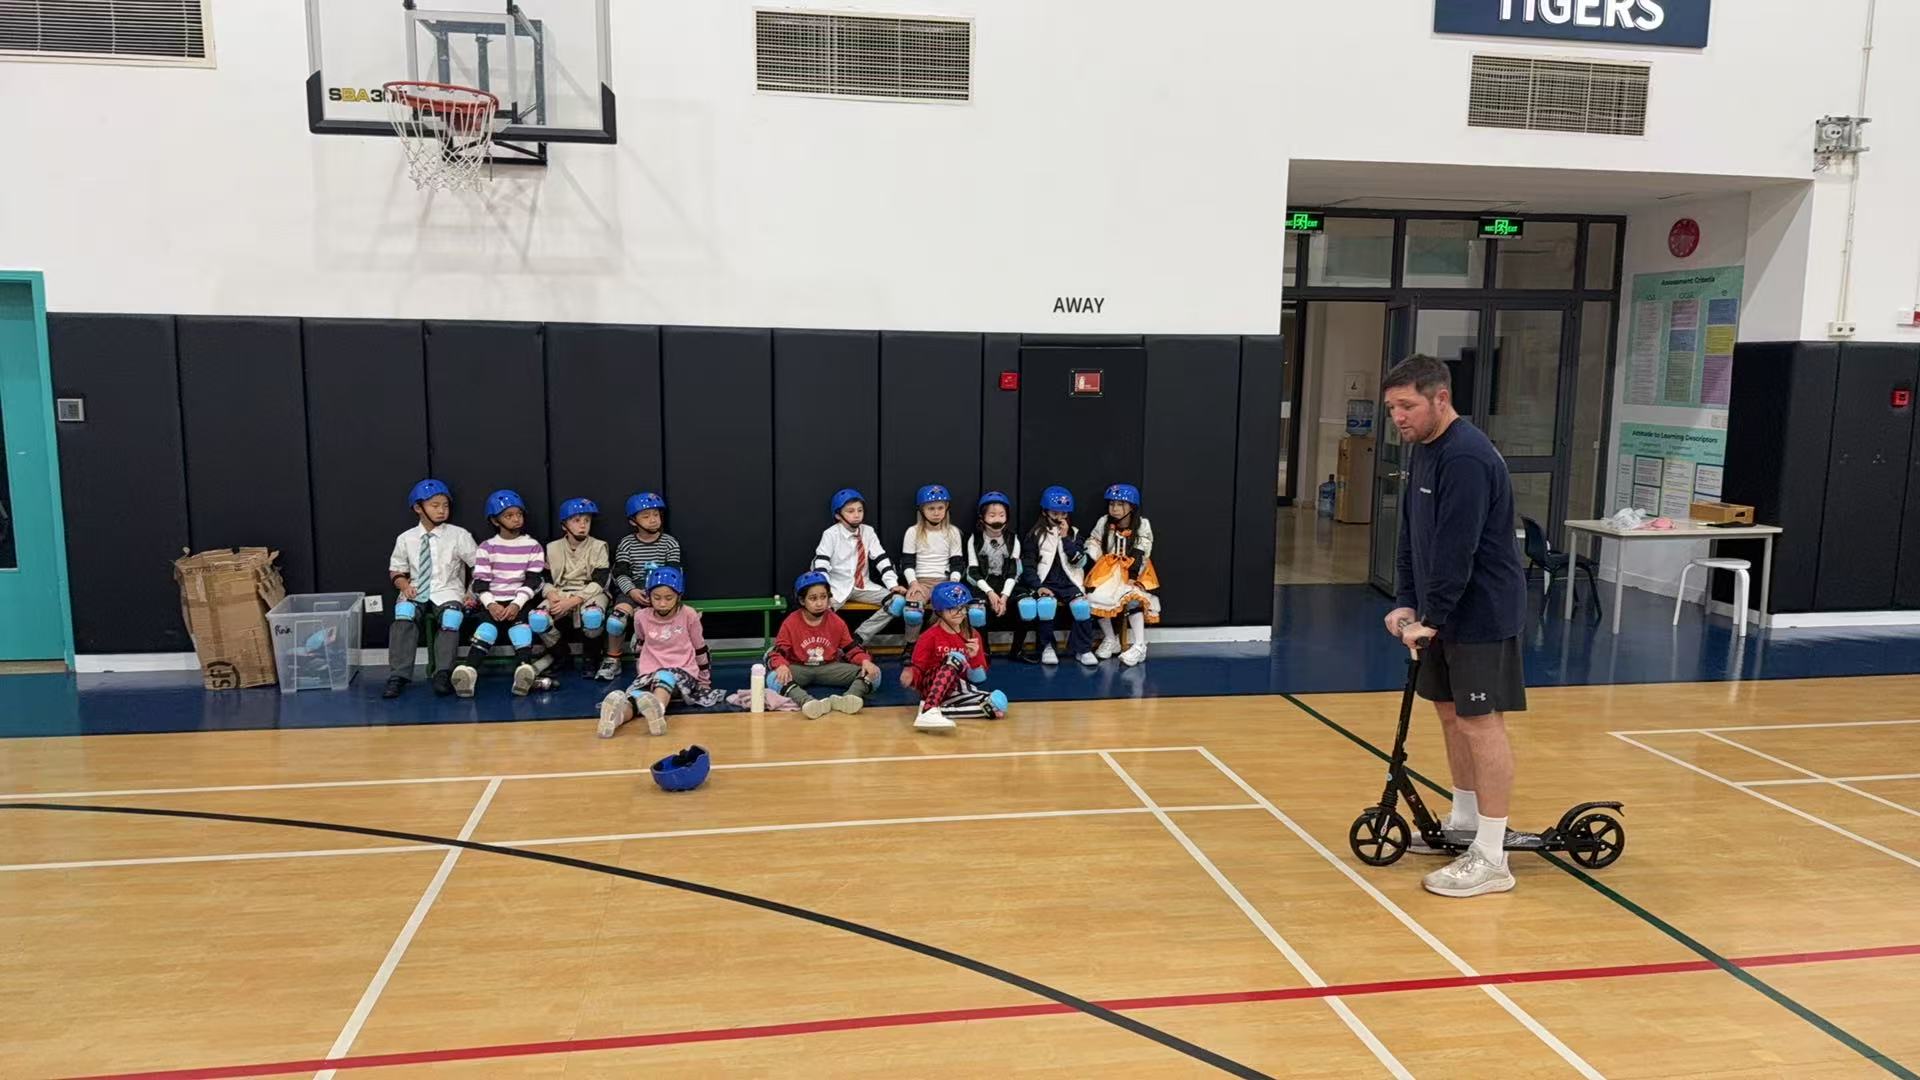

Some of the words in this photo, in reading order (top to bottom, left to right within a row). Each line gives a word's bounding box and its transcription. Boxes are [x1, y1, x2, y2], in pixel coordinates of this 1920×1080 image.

[1053, 297, 1105, 313] AWAY
[1661, 432, 1684, 442] Learning
[1685, 434, 1718, 444] Descriptors
[937, 645, 965, 653] TOMM
